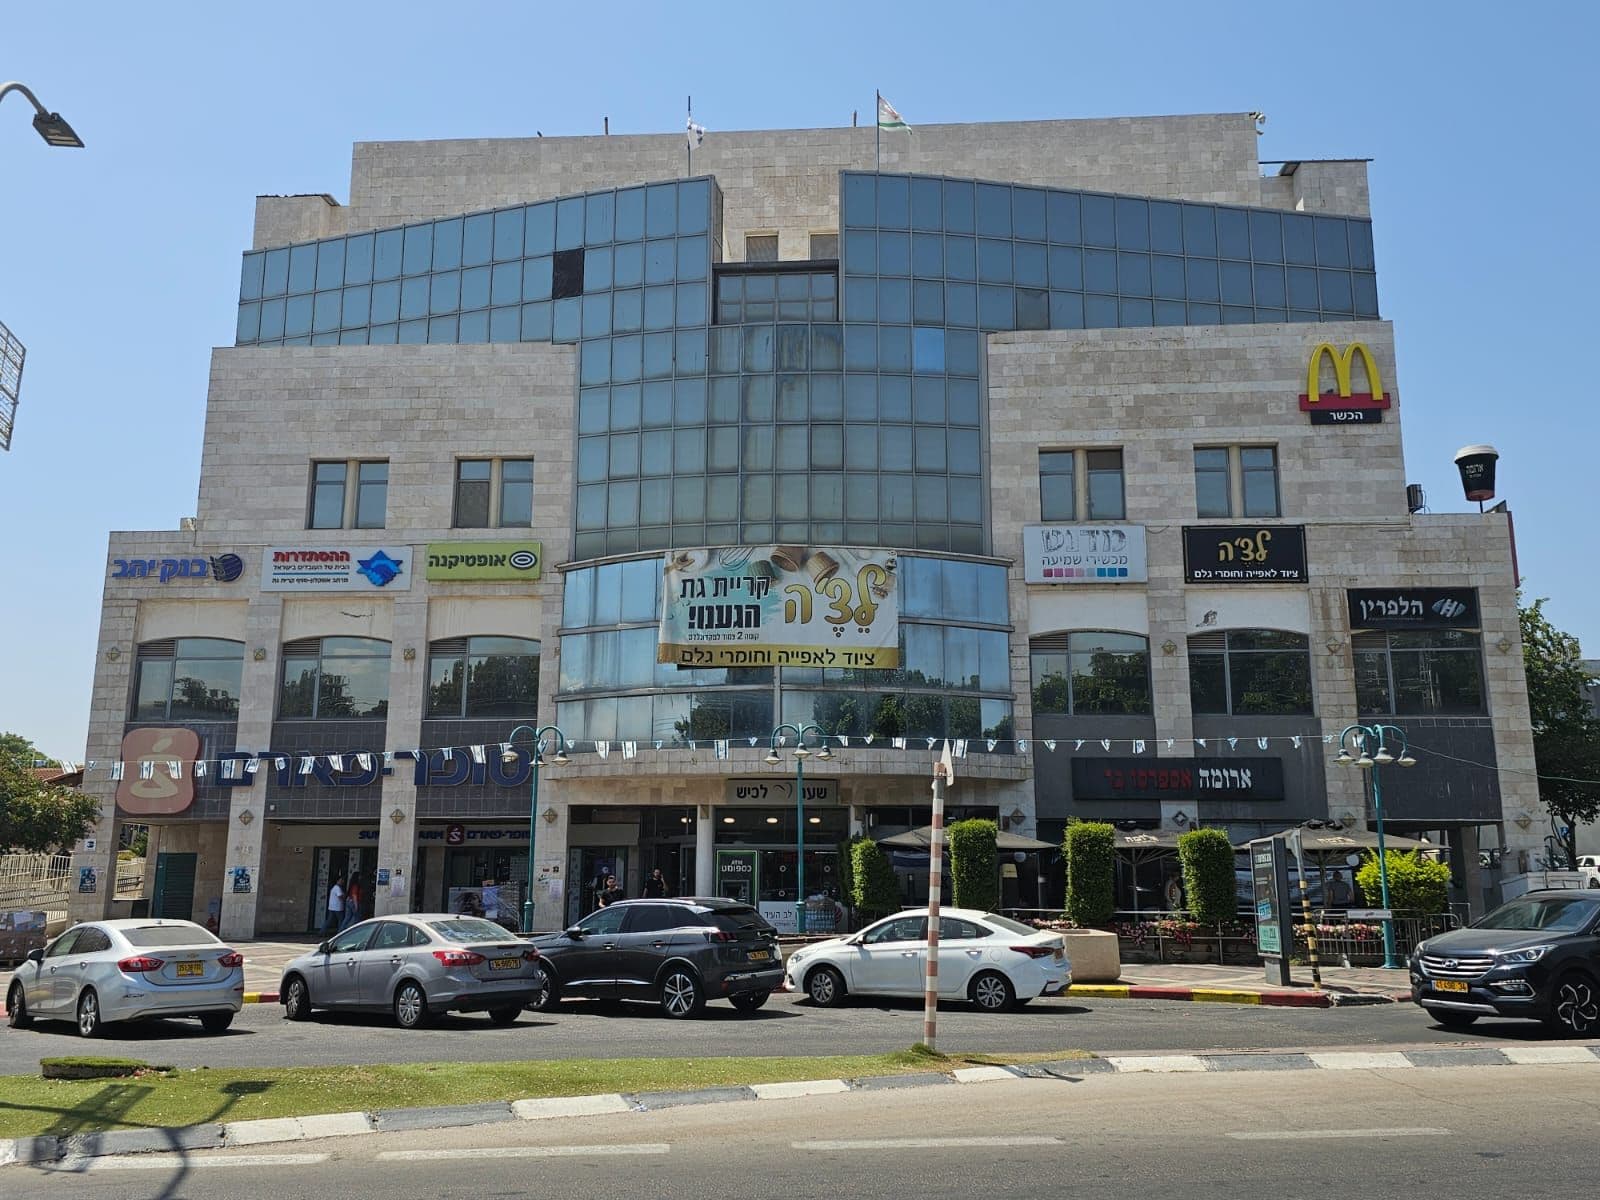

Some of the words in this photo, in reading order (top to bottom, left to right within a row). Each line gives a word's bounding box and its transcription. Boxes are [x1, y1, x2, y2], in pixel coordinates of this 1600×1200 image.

[1329, 411, 1363, 421] הכשר
[272, 551, 350, 562] ההסתדרות
[429, 554, 506, 569] אופטיקנה
[1042, 555, 1083, 566] שמיעה
[1086, 555, 1128, 565] מכשירי
[112, 559, 156, 577] יהב
[159, 558, 207, 583] בנק
[1194, 569, 1212, 578] גלם
[1215, 570, 1243, 578] וחומרי
[1246, 569, 1278, 578] לאפייה
[1280, 570, 1299, 578] ציוד
[680, 578, 706, 598] גת
[712, 576, 771, 600] קריית
[1360, 596, 1423, 620] הלפרין
[688, 604, 761, 629] הגענו!
[737, 631, 743, 640] 2
[681, 647, 713, 663] גלם
[720, 650, 770, 663] וחומרי
[778, 648, 836, 664] לאפייה
[842, 652, 875, 665] ציוד
[1130, 768, 1194, 789] אספרסו
[1198, 767, 1251, 789] ארומה
[736, 784, 768, 799] לכיש
[783, 909, 792, 919] לב
